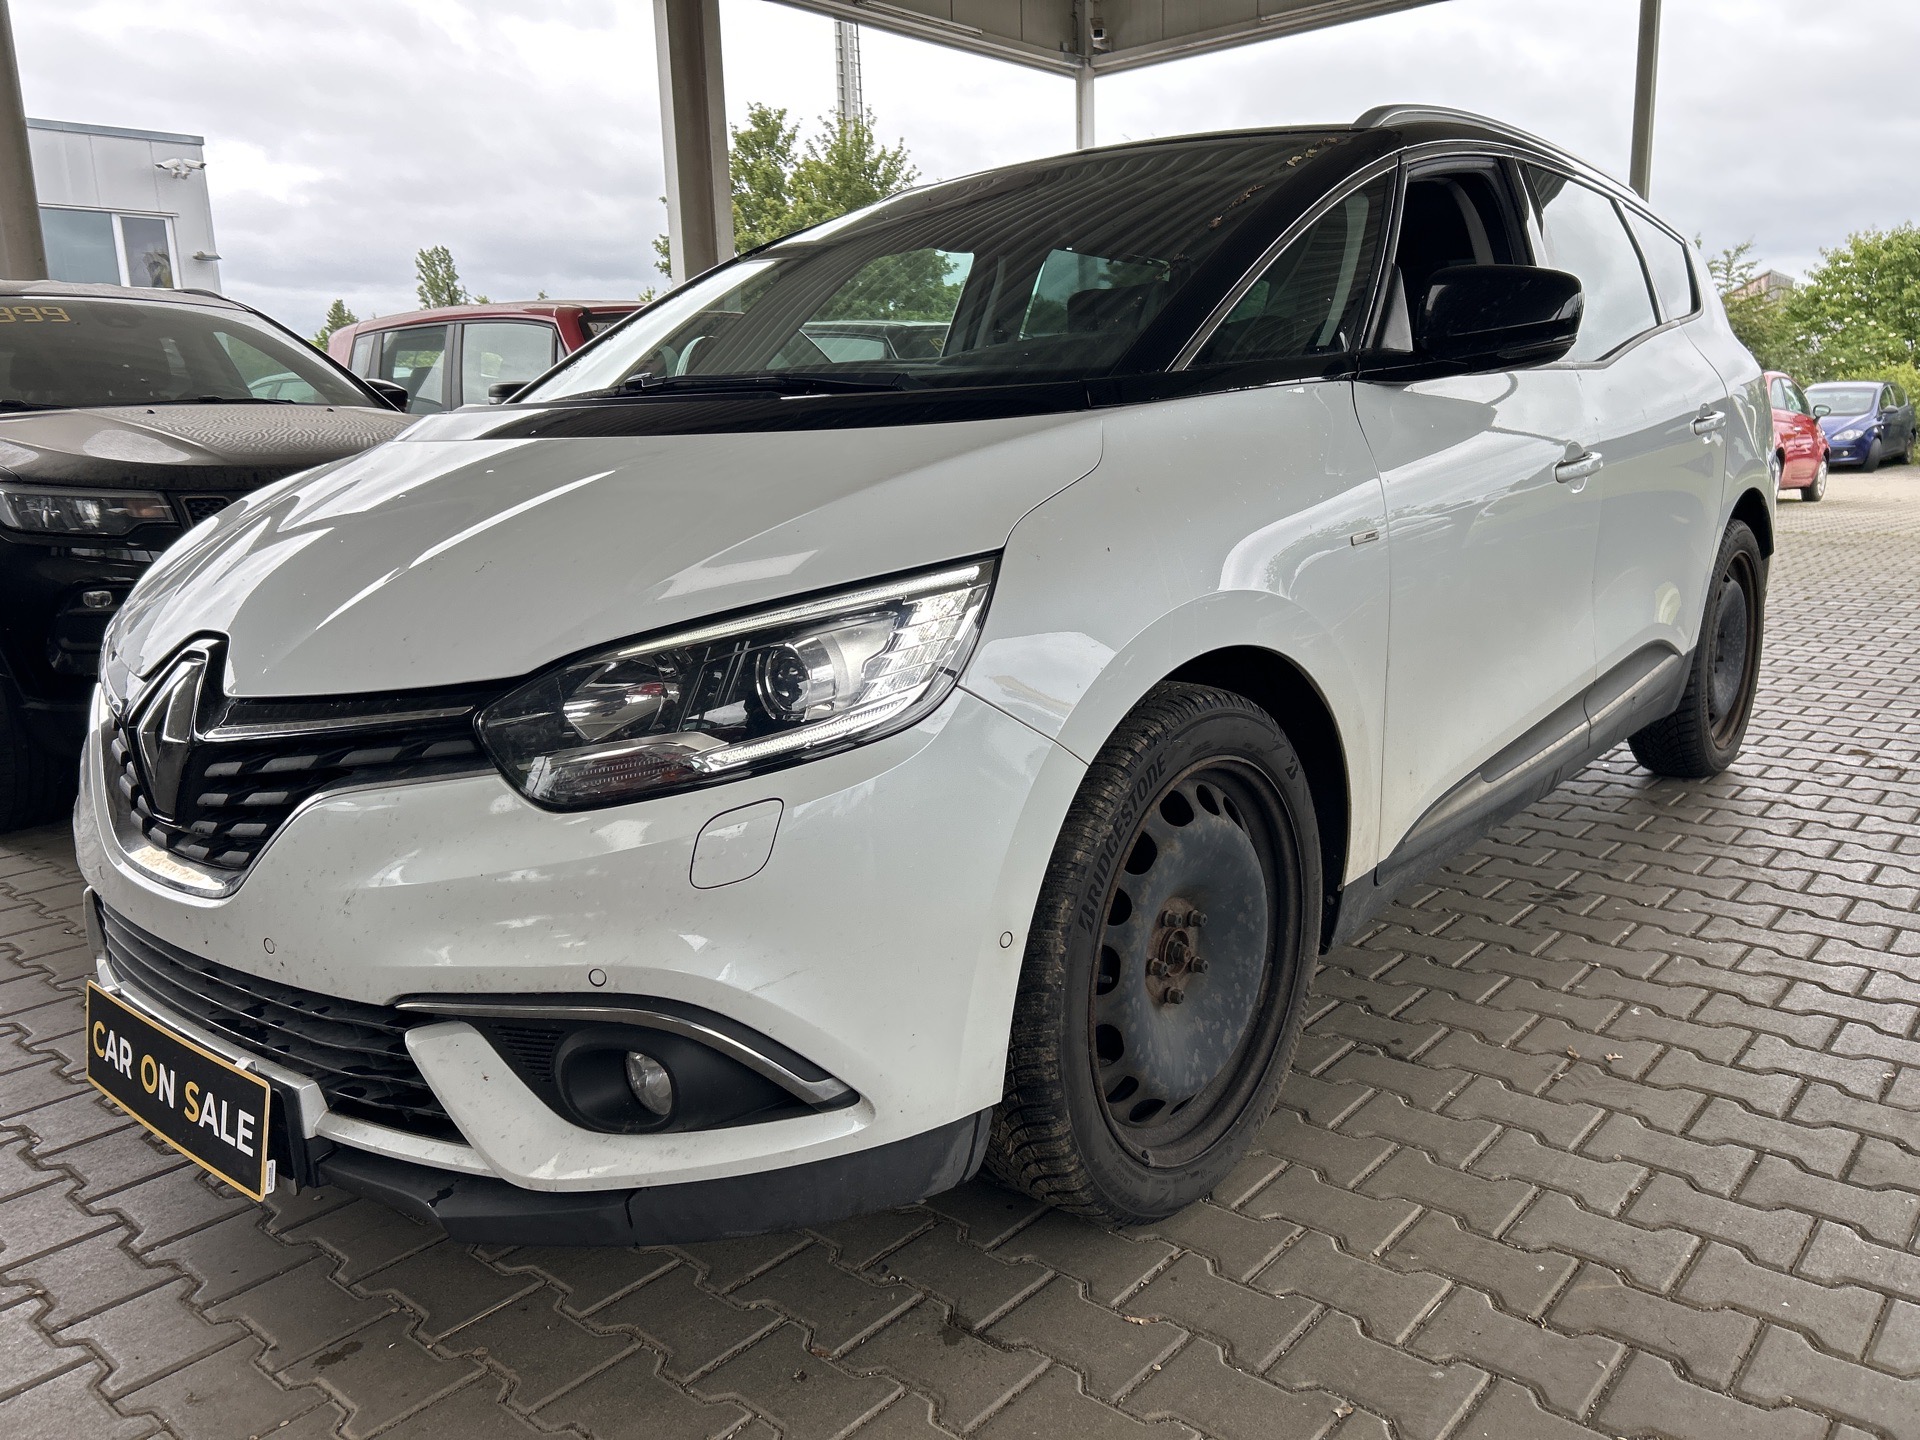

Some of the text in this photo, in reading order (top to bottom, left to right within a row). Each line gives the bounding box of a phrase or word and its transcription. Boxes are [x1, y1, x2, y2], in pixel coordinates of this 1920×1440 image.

[1078, 753, 1167, 934] BRIDGESTONE
[92, 1020, 255, 1158] CAR ON SALE
